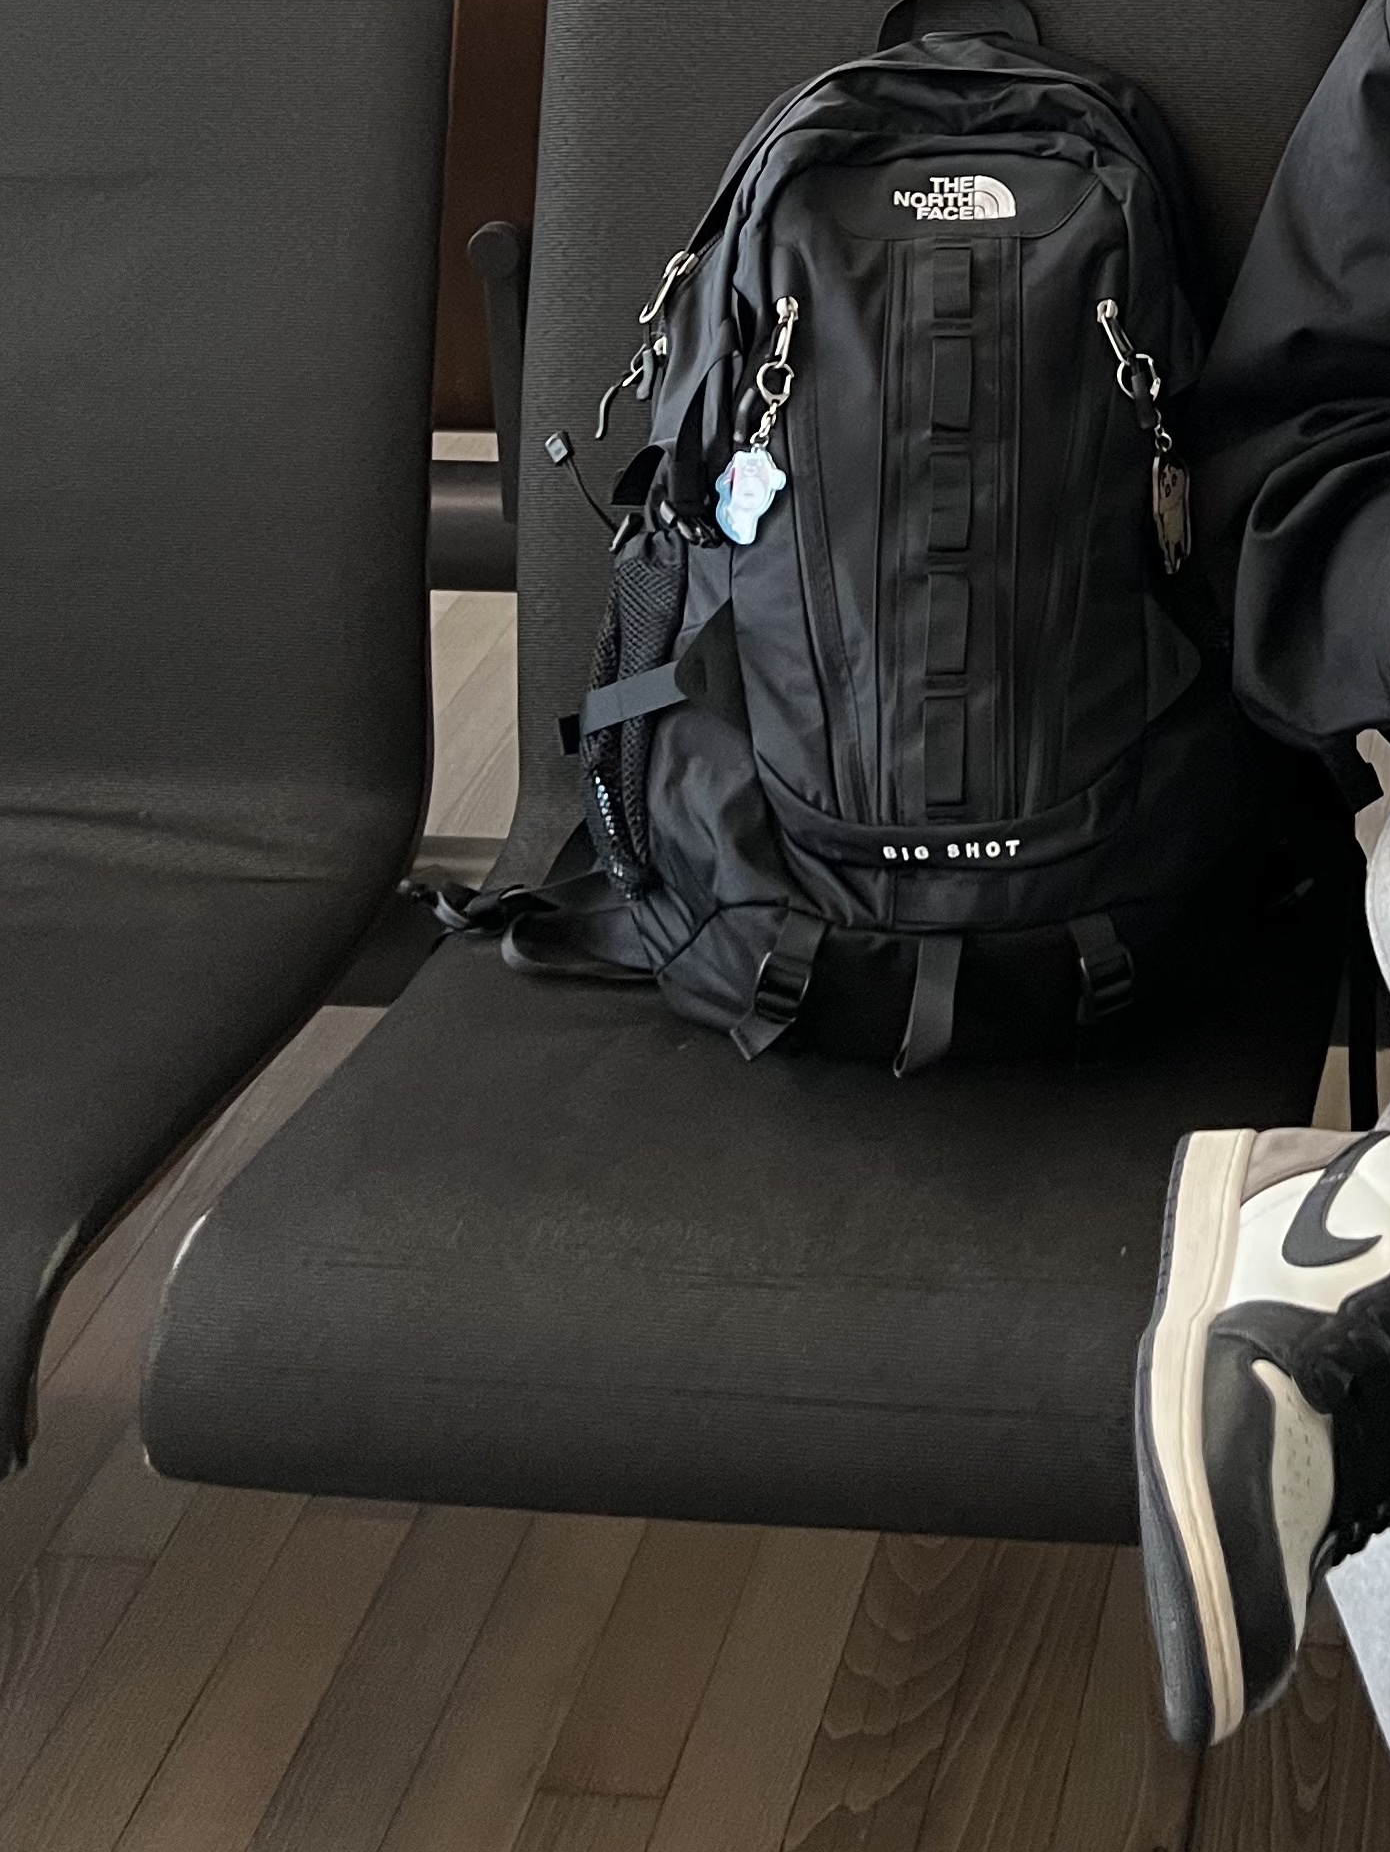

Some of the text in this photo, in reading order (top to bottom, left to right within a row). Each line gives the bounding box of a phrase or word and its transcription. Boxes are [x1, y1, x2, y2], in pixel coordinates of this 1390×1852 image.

[929, 176, 974, 193] THE
[893, 190, 974, 208] NORTH
[916, 206, 974, 220] FACE
[882, 839, 1021, 861] BIG SHOT
